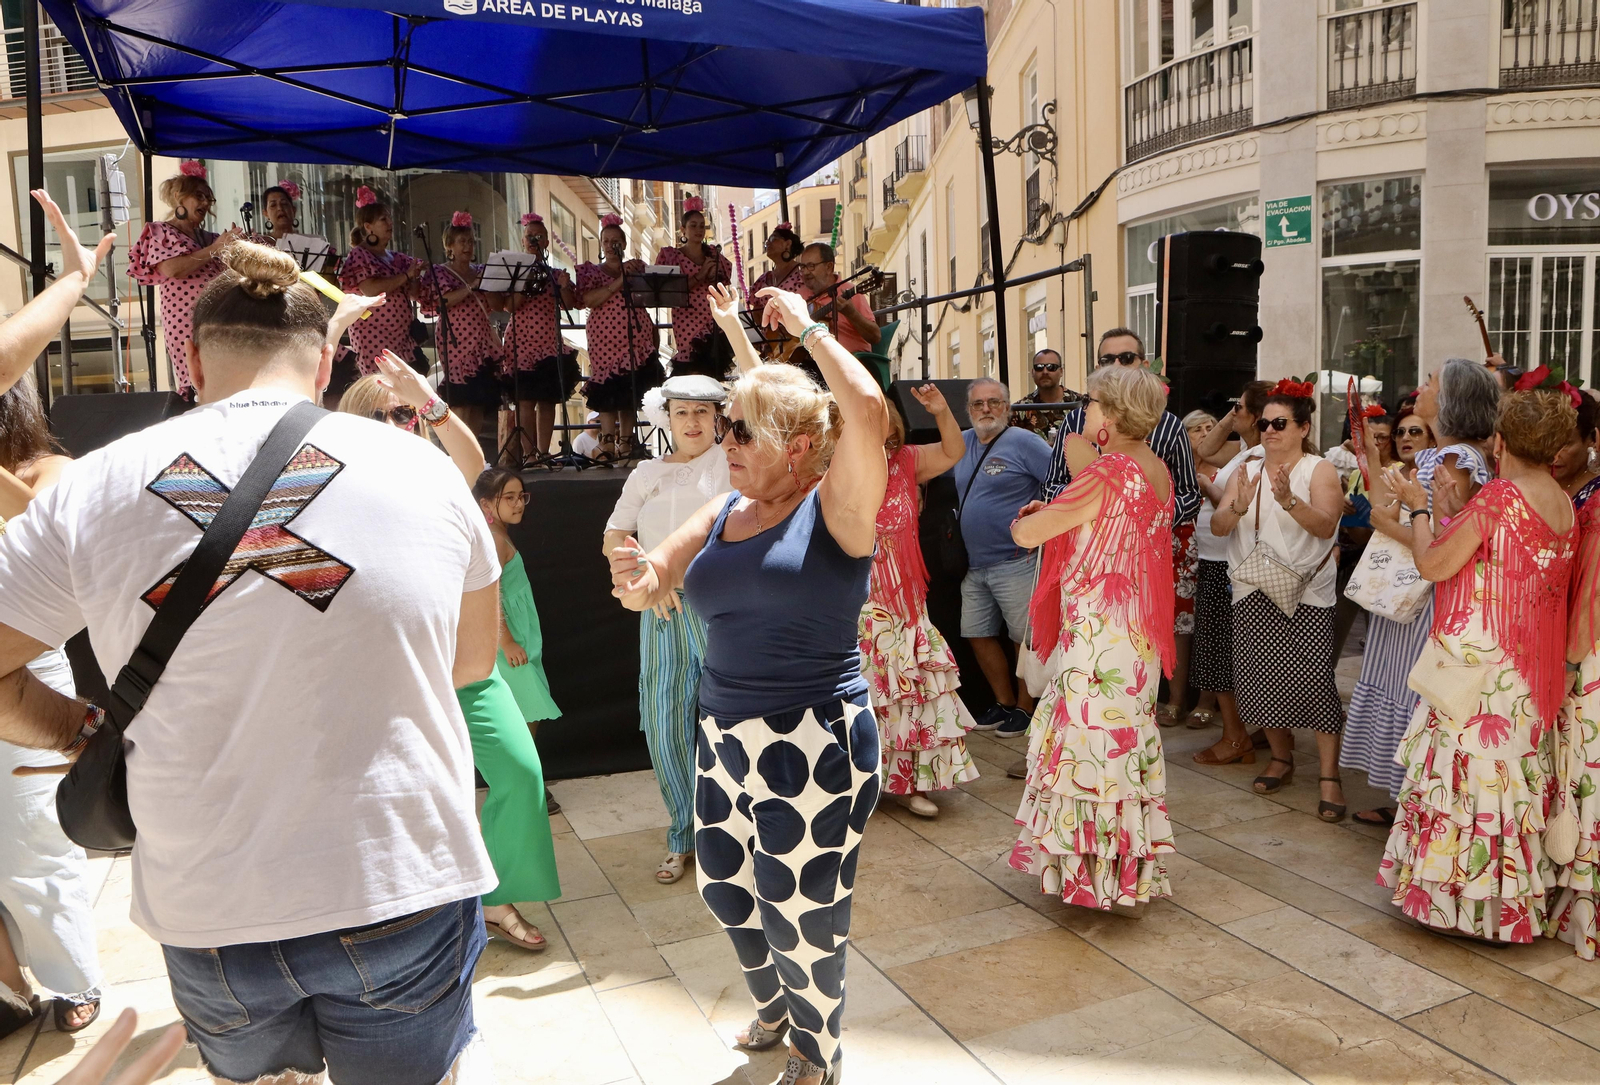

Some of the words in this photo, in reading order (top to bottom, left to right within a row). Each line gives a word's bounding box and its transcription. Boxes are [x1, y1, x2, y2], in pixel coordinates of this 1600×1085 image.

[541, 3, 566, 19] DE
[571, 6, 643, 27] PLAYAS
[1266, 205, 1311, 216] EVACUACION
[1527, 193, 1600, 221] OYS
